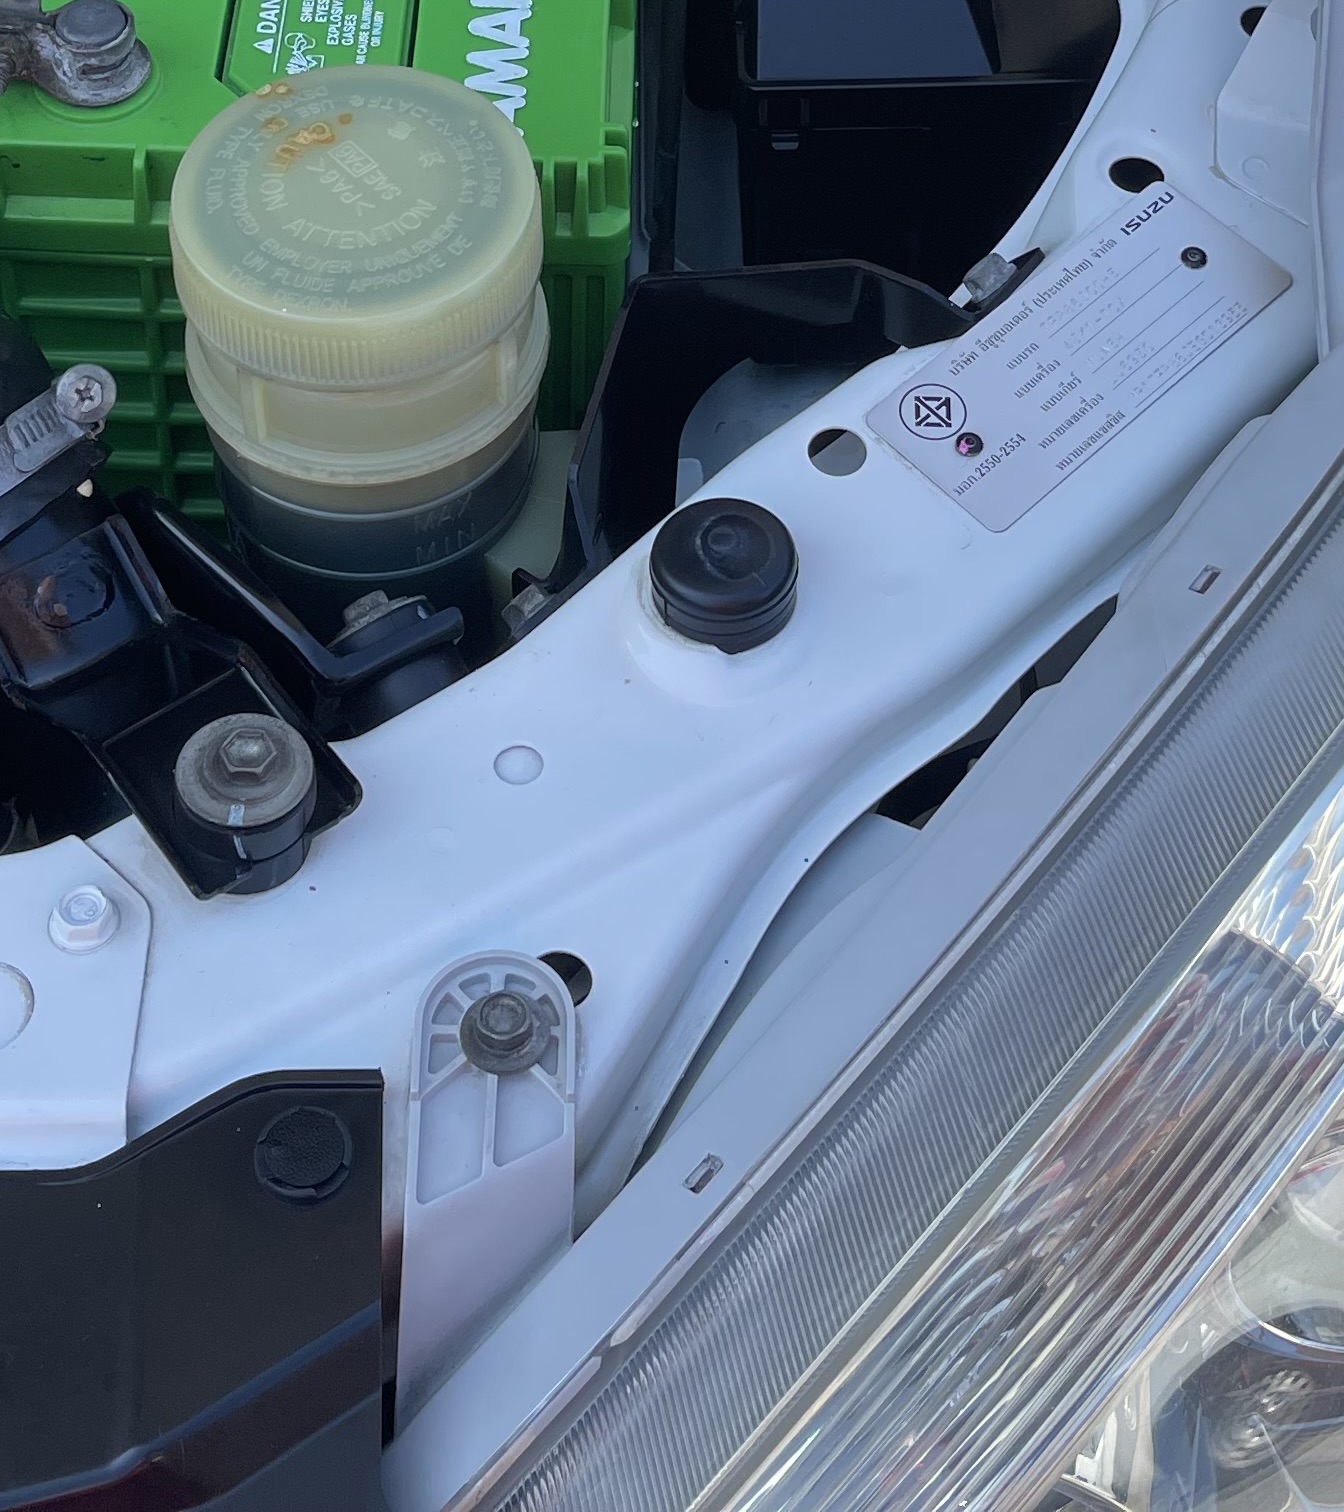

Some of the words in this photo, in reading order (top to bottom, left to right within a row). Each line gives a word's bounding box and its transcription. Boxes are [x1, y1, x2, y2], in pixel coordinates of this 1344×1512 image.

[341, 14, 358, 46] GASES
[356, 30, 370, 55] CAUSE
[370, 36, 381, 47] OR
[371, 10, 385, 36] INJURY
[296, 101, 335, 118] USE
[214, 126, 253, 161] TYPE
[261, 120, 335, 212] CAUTION
[360, 171, 403, 201] SAE
[229, 157, 260, 236] APPROVED
[258, 238, 353, 275] EMPLOYER
[364, 211, 464, 272] UNIQUEMENT
[282, 198, 438, 250] ATTENTION
[227, 263, 271, 297] TYPE
[240, 250, 268, 273] UN
[271, 267, 336, 293] FLUIDE
[347, 254, 448, 294] APPROUVE
[449, 235, 474, 256] DE
[948, 351, 980, 376] บริษัท
[1031, 258, 1094, 309] (ประเทศไทย)
[1089, 238, 1118, 259] จำกัด
[1118, 191, 1176, 237] ISUZU
[1006, 342, 1040, 370] แบบรถ
[1014, 359, 1061, 399] แบบเครื่อง
[1039, 371, 1082, 412] แบบเกียร์
[1037, 393, 1105, 449] หมายเลขเครื่อง
[954, 433, 1027, 496] มอก.2550-2554
[414, 491, 473, 534] MAX
